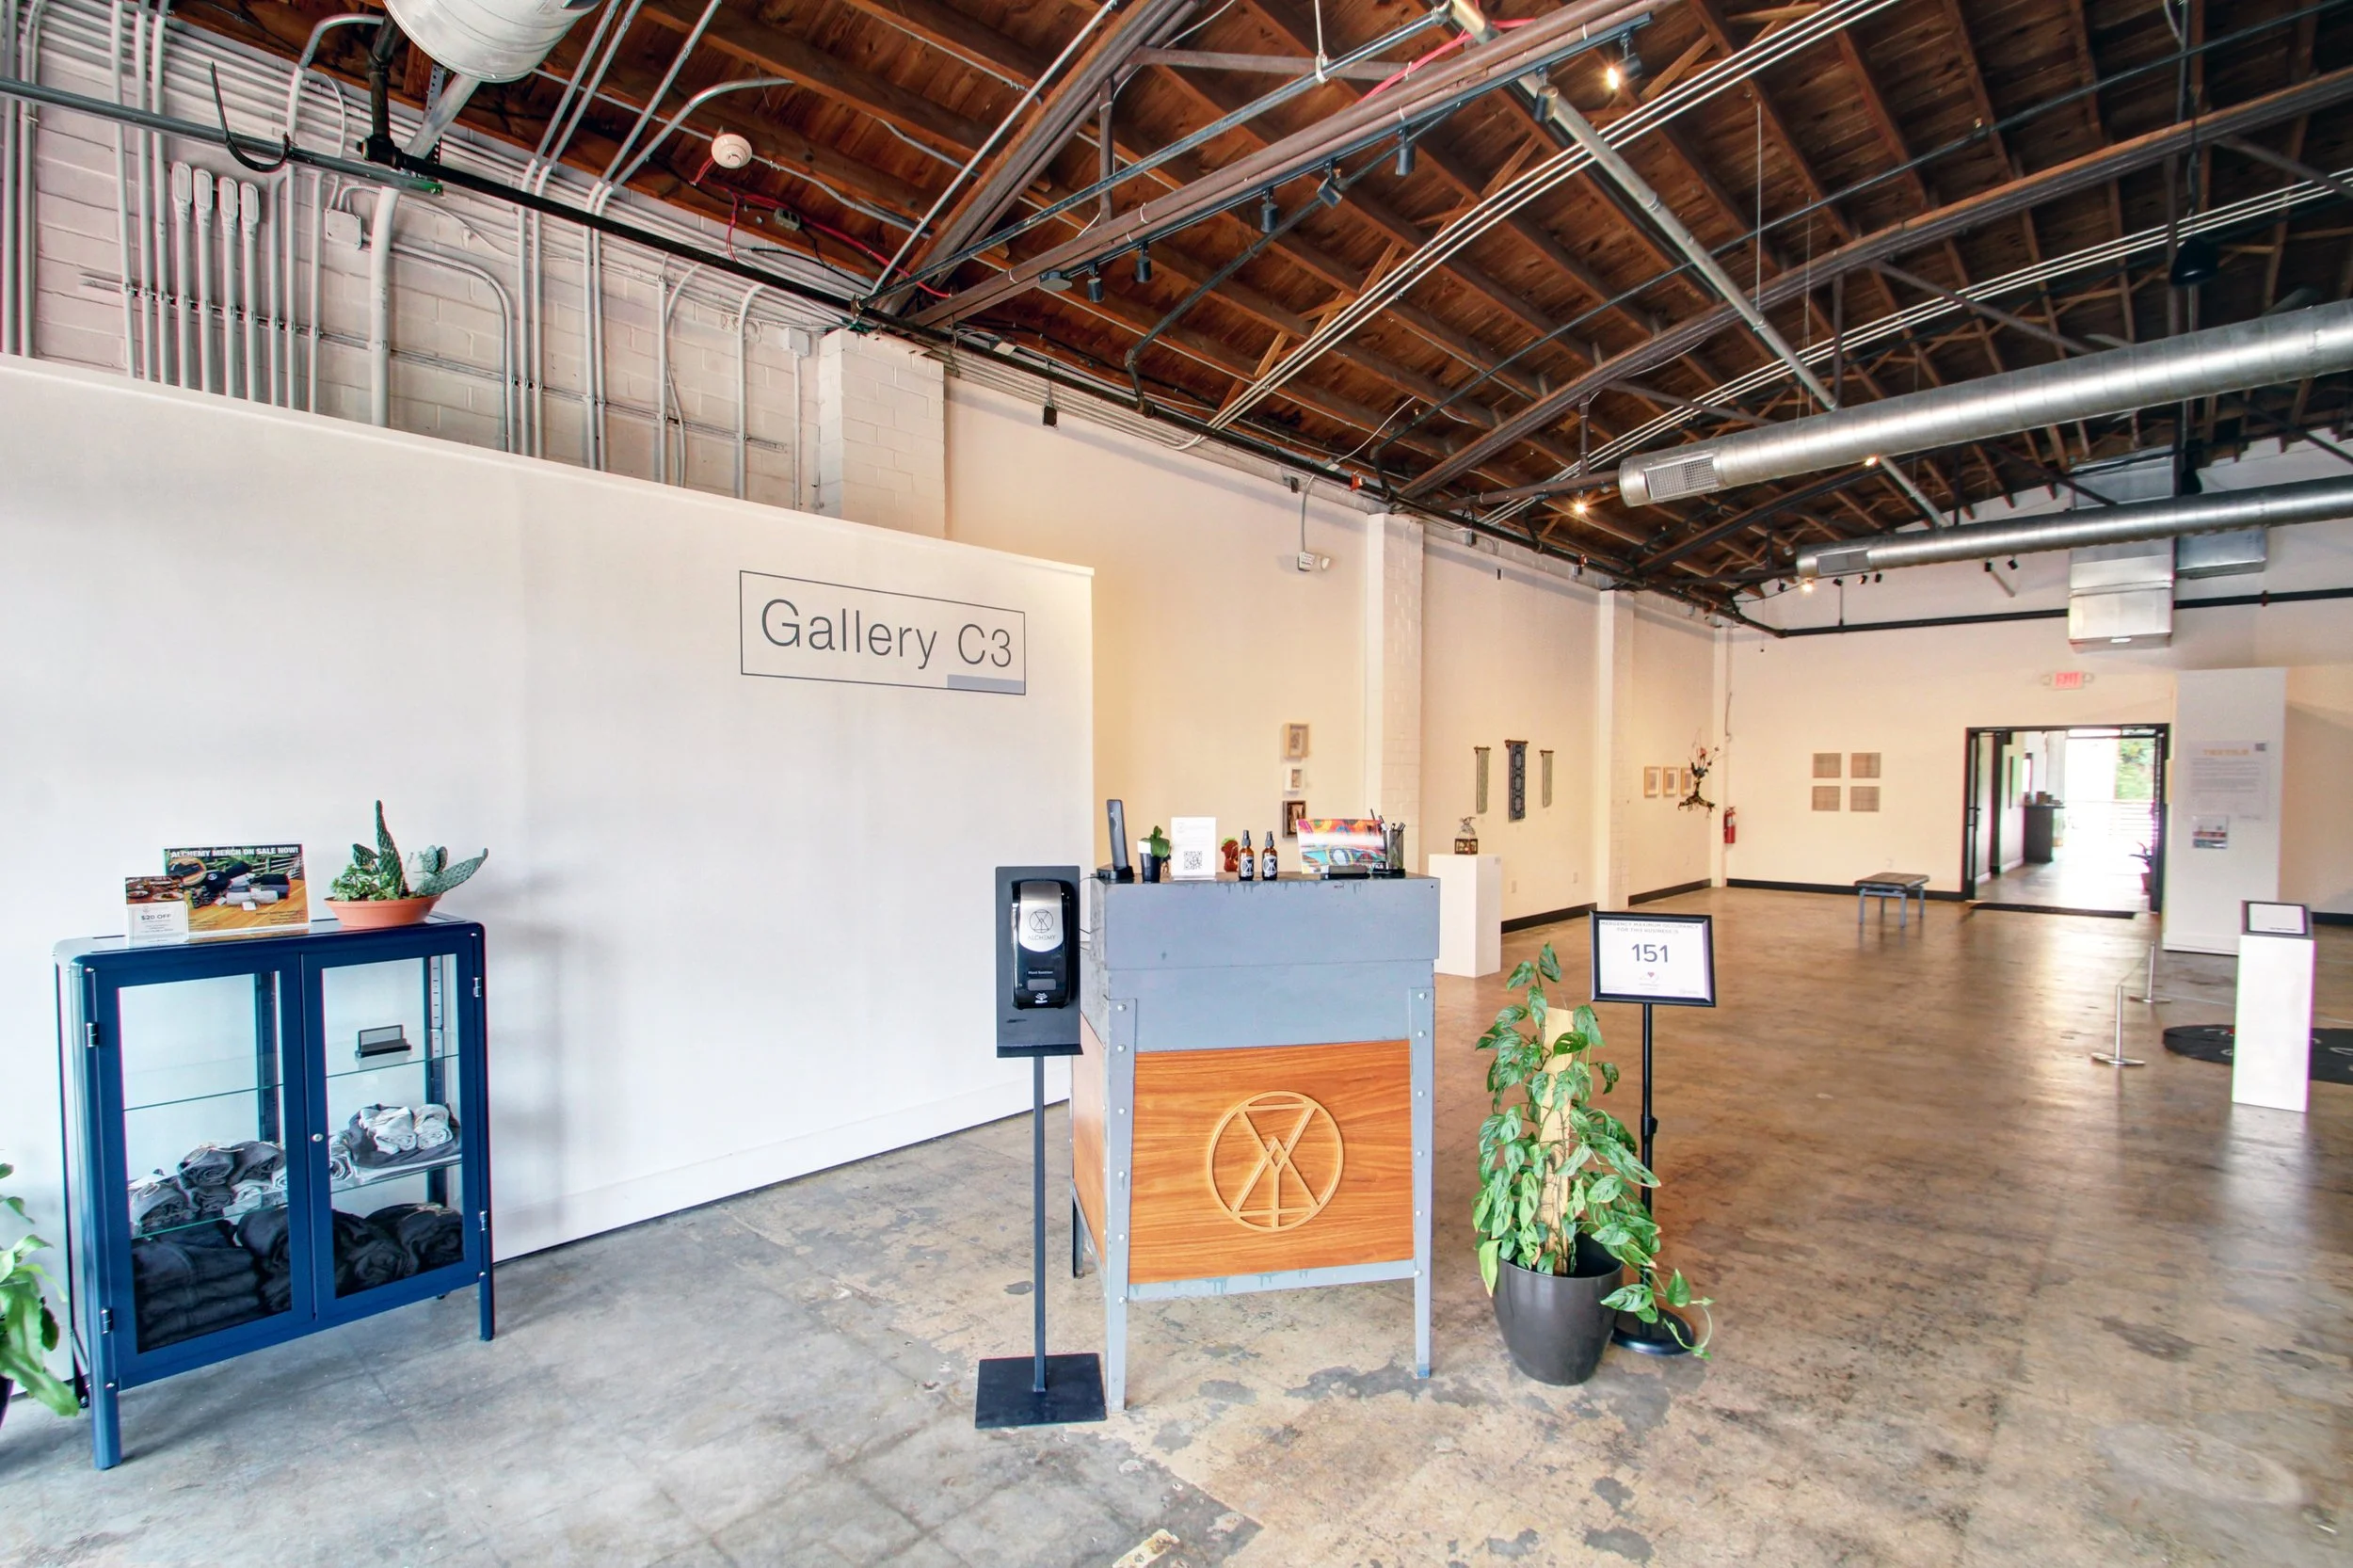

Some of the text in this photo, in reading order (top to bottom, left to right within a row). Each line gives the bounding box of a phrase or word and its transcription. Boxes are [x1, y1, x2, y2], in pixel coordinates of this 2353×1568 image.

[761, 599, 1012, 669] Gallery C3
[170, 849, 210, 858] ALCHEMY
[212, 848, 242, 856] MERCH
[1631, 943, 1669, 963] 151
